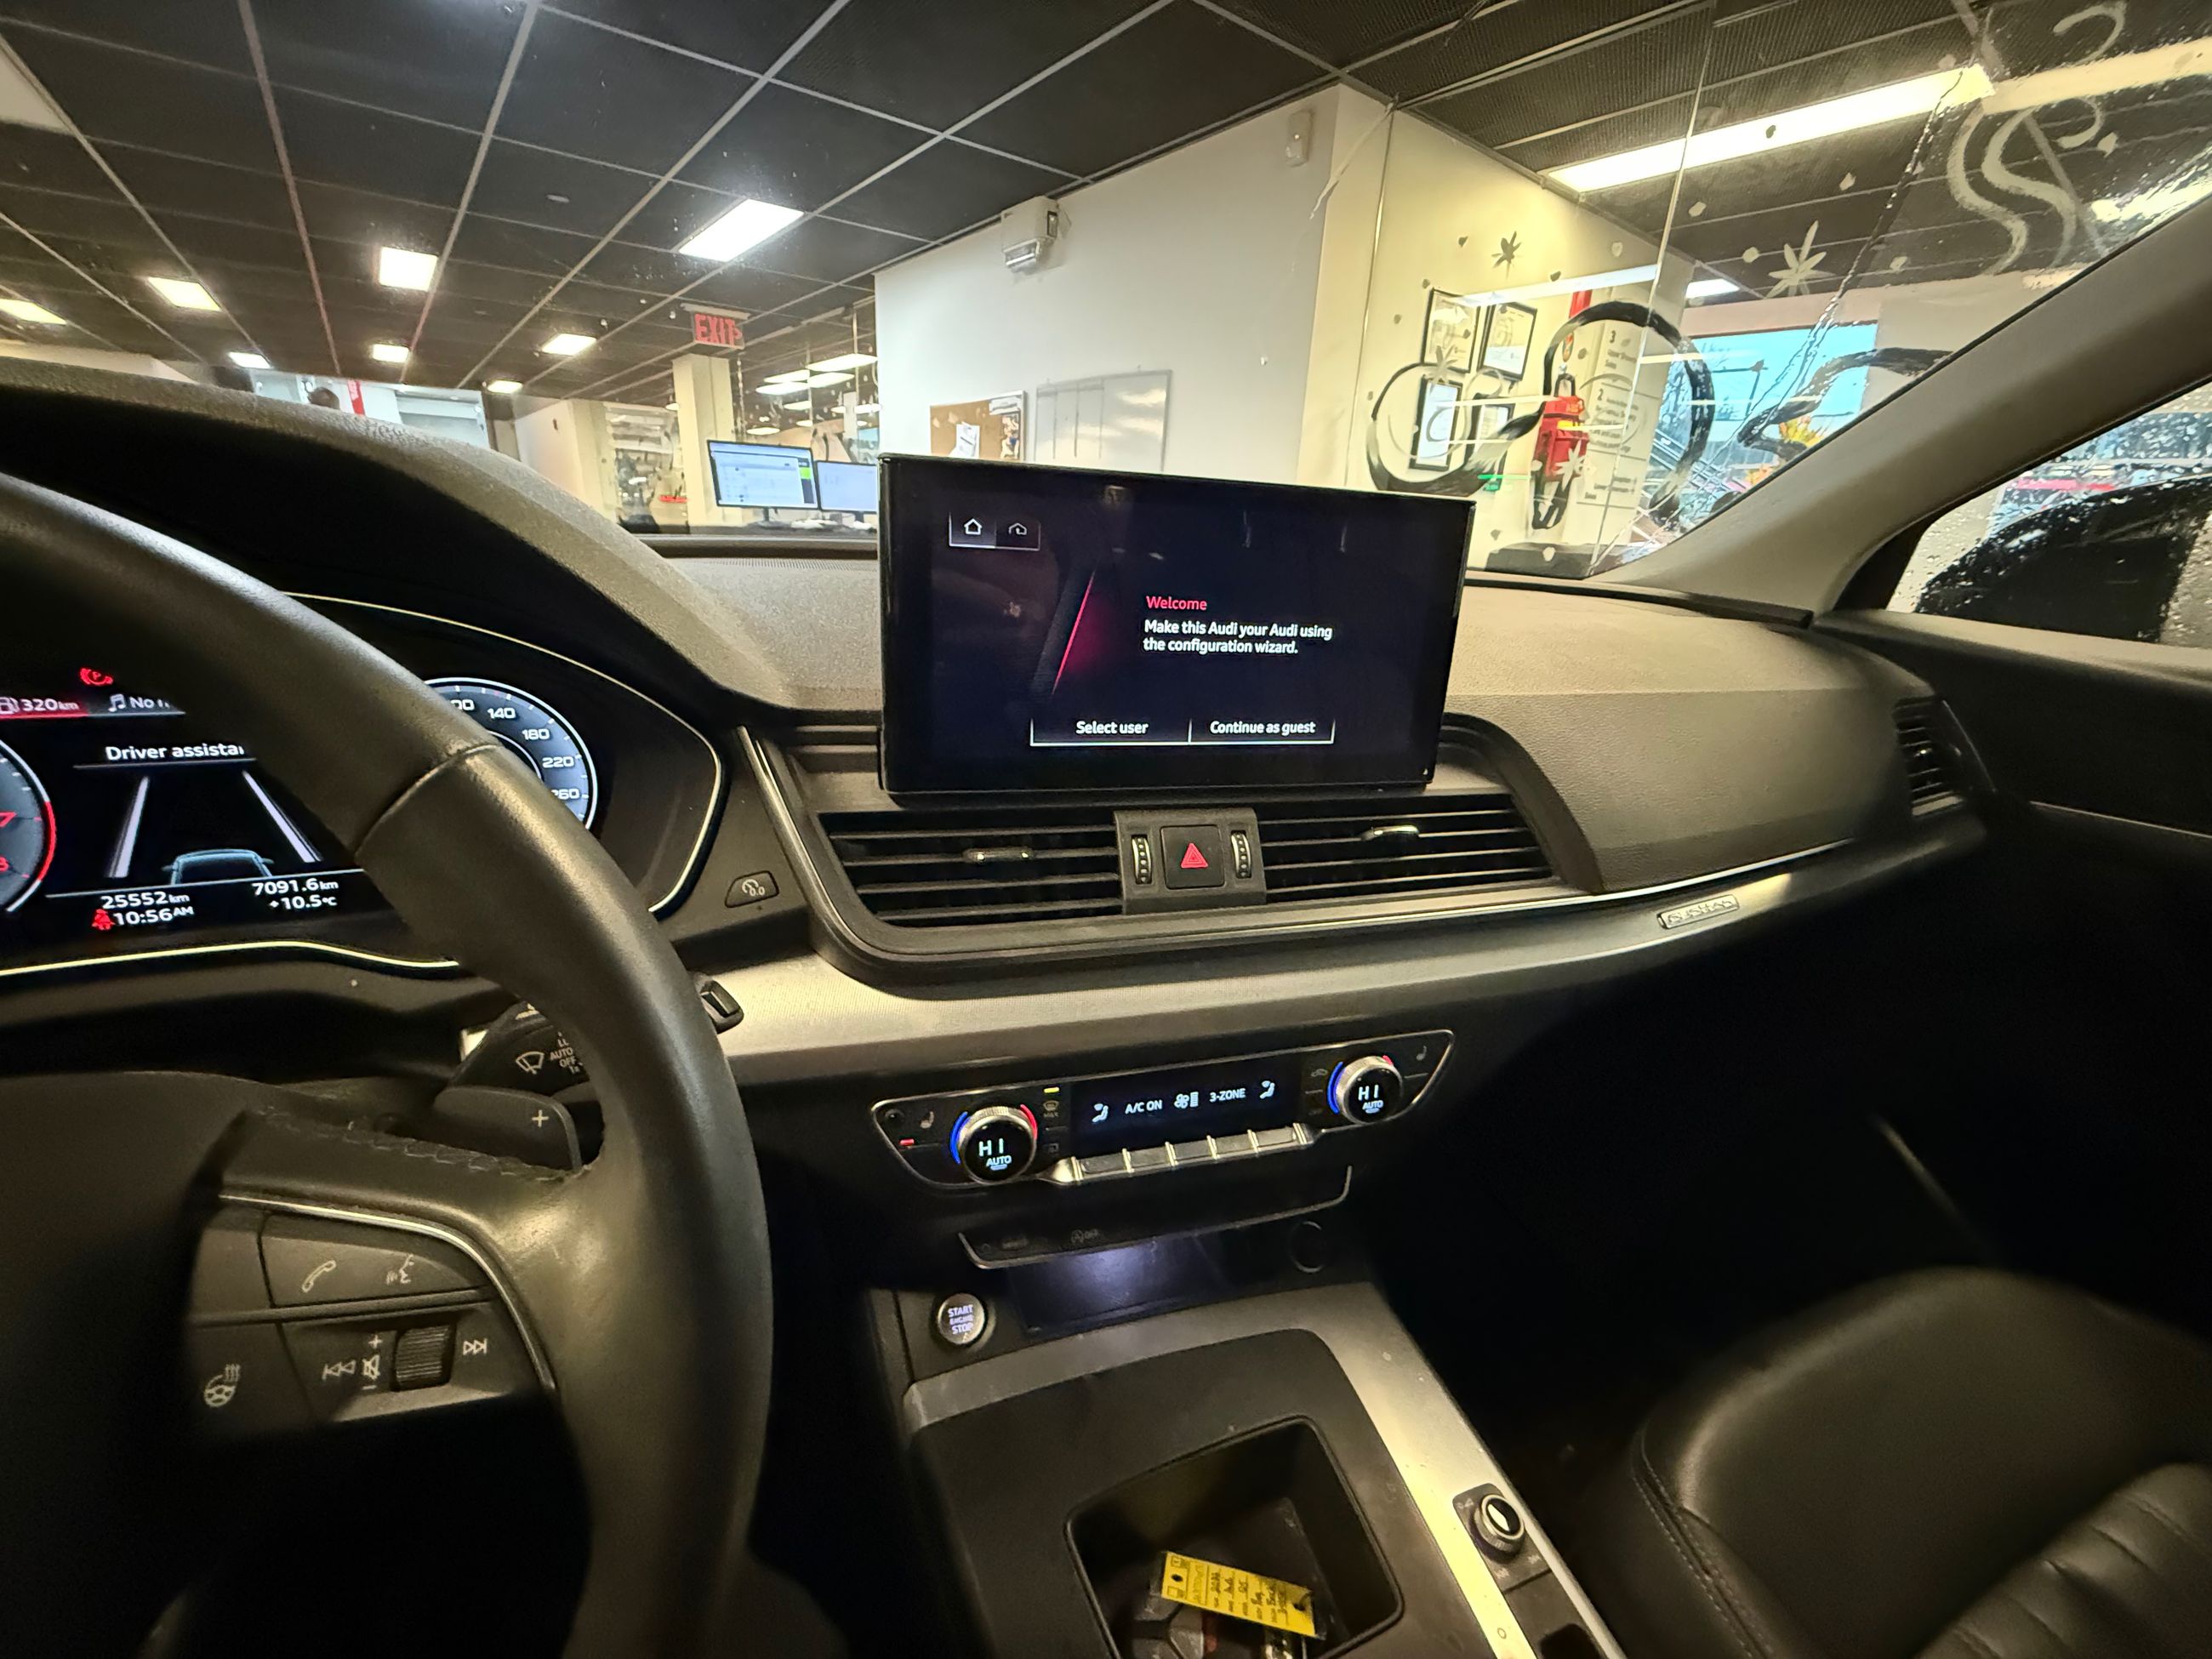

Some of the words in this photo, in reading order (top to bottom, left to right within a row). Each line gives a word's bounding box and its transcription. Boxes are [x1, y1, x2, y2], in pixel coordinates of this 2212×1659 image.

[694, 313, 735, 346] EXIT
[1146, 596, 1207, 610] Welcome
[1144, 619, 1179, 634] Make
[1181, 620, 1206, 635] this
[1208, 621, 1238, 636] Audi
[1238, 624, 1268, 639] your
[1268, 623, 1298, 637] Audi
[1299, 624, 1333, 641] using
[1143, 636, 1166, 651] the
[1167, 637, 1253, 655] configuration
[1255, 641, 1298, 654] wizard.
[129, 697, 154, 709] No
[487, 707, 516, 720] 140
[521, 728, 550, 741] 180
[1075, 721, 1118, 734] Select
[1120, 722, 1149, 734] user
[1210, 721, 1264, 734] Continue
[1266, 724, 1280, 734] as
[1281, 722, 1316, 737] guest
[105, 745, 168, 761] Driver
[542, 755, 575, 769] 220
[550, 1047, 573, 1061] AUTO
[559, 1056, 576, 1068] OFF
[1209, 1088, 1246, 1103] 3-ZONE
[1358, 1084, 1379, 1101] HI
[1125, 1102, 1145, 1115] A/C
[1146, 1099, 1163, 1111] ON
[1362, 1100, 1384, 1110] AUTO
[978, 1138, 1004, 1157] HI
[986, 1155, 1012, 1167] AUTO
[948, 1304, 973, 1318] START
[952, 1322, 974, 1335] STOP
